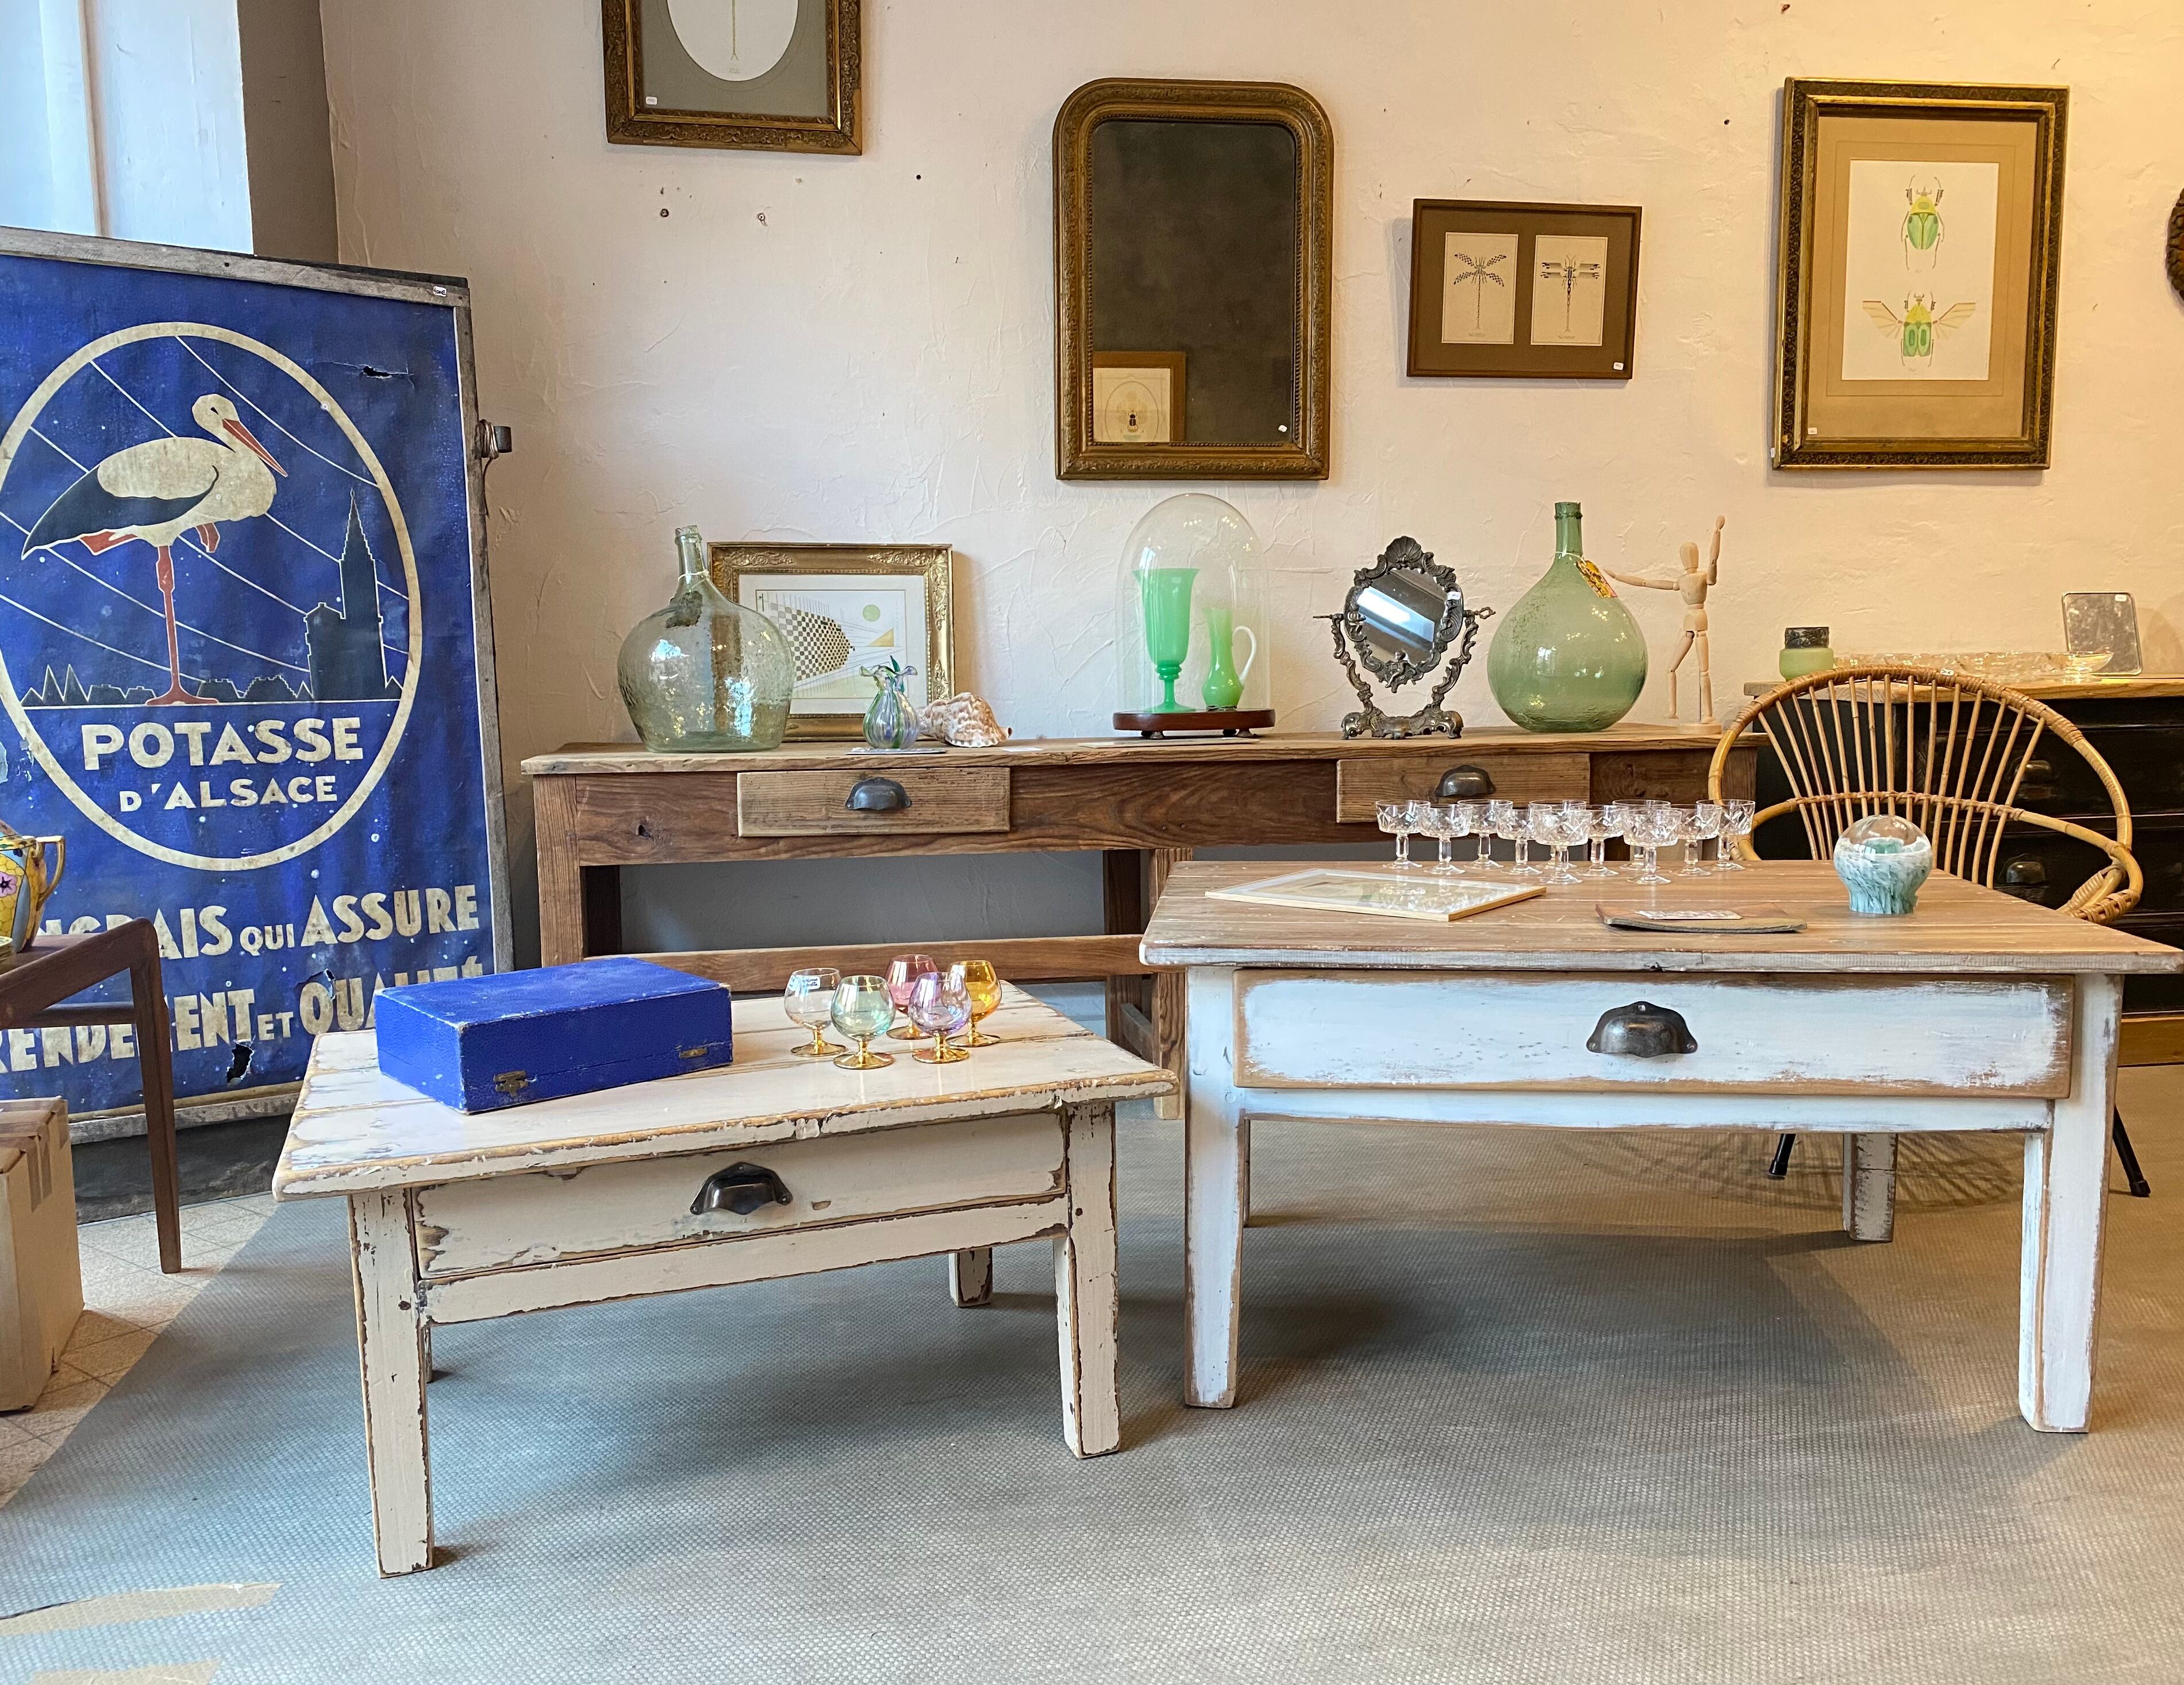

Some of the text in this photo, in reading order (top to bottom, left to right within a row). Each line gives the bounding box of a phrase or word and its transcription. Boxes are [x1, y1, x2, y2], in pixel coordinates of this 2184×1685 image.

[81, 717, 363, 771] POTASSE
[120, 776, 337, 812] D'ALSACE
[240, 924, 295, 956] QUI
[301, 885, 479, 947] ASSURE
[0, 988, 255, 1074] ENDEENT
[257, 1012, 294, 1041] ET
